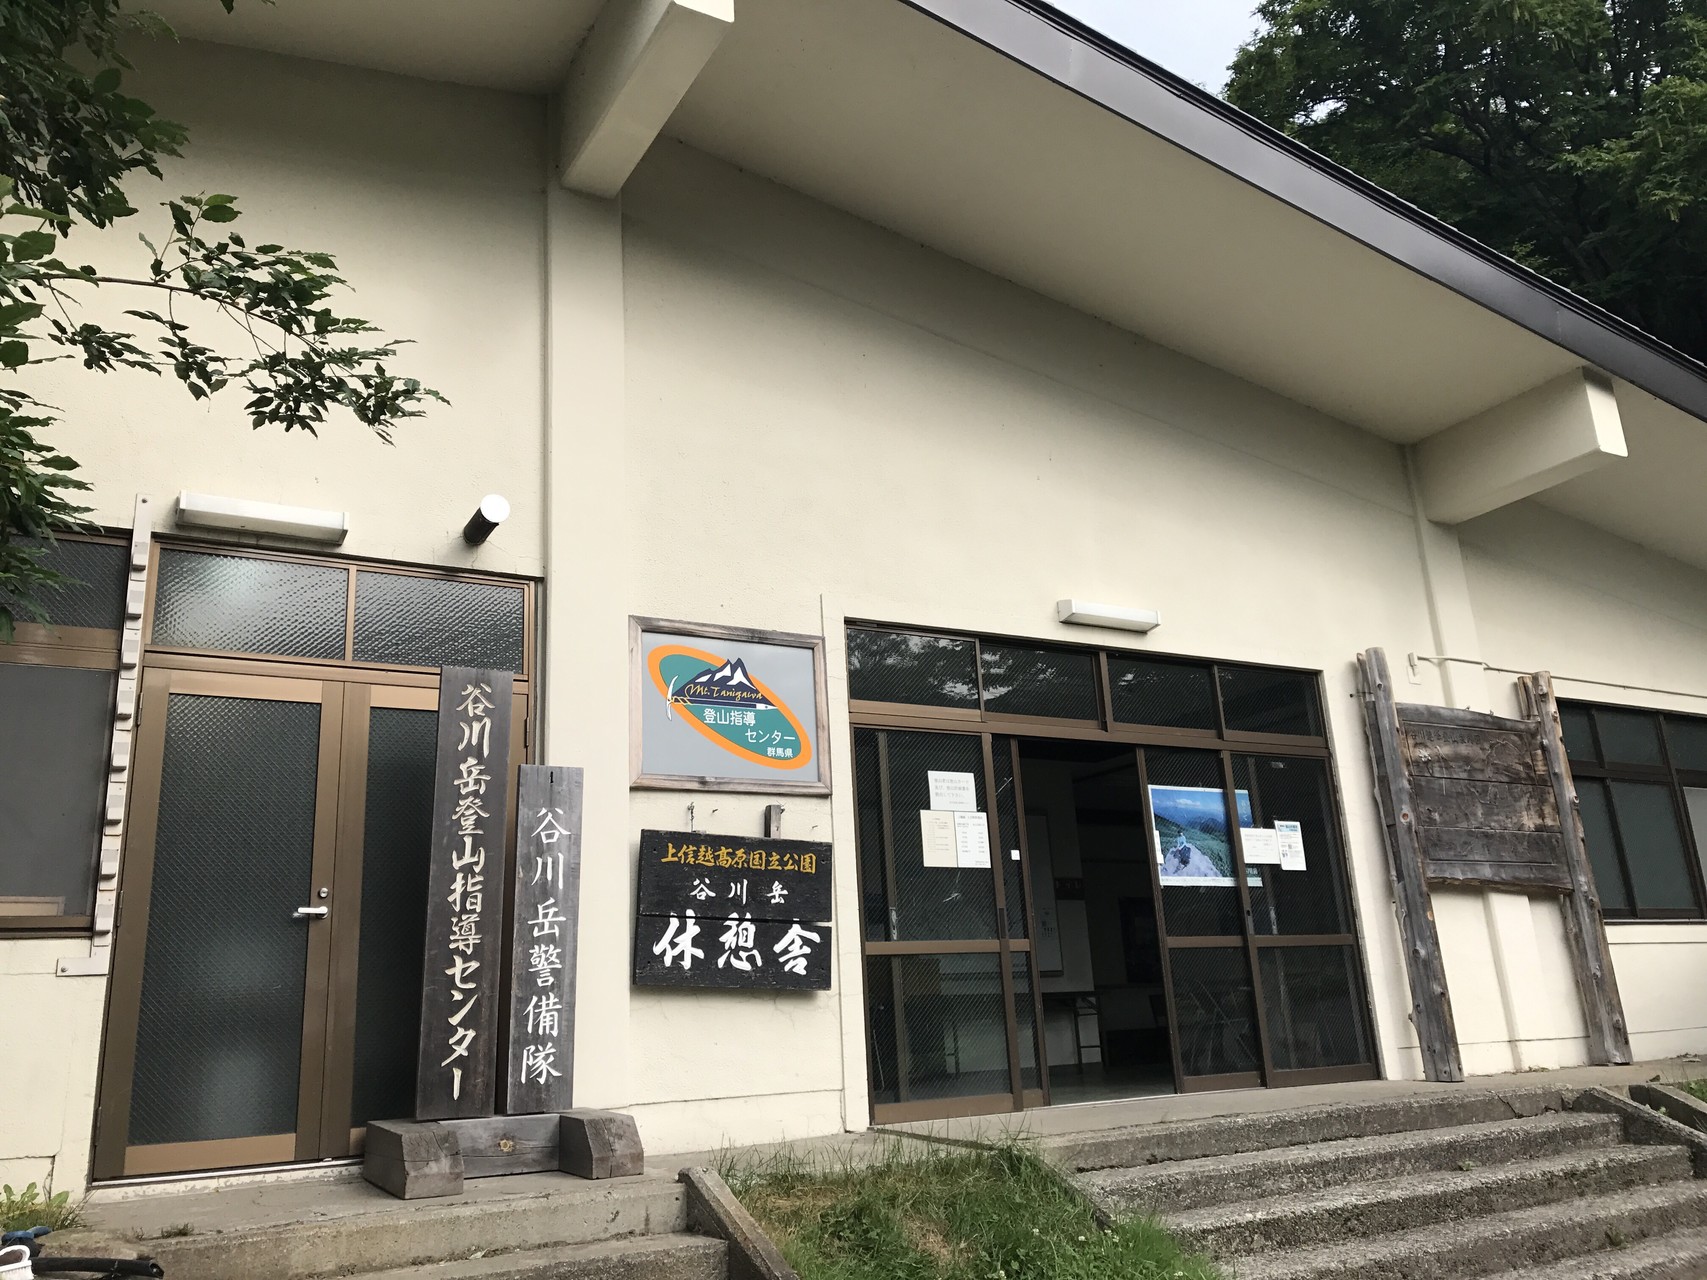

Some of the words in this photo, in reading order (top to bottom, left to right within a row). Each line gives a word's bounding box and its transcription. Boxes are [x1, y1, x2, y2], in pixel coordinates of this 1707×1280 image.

[685, 683, 710, 697] Mt.
[710, 686, 763, 701] Tanigawa
[703, 708, 756, 727] 登山指導
[744, 729, 796, 745] センター
[766, 747, 794, 759] 群馬県
[441, 682, 495, 1101] 谷川岳登山指導センター
[689, 878, 789, 905] 谷川岳
[520, 807, 571, 1085] 谷川岳警備隊
[652, 908, 821, 976] 休憩舎
